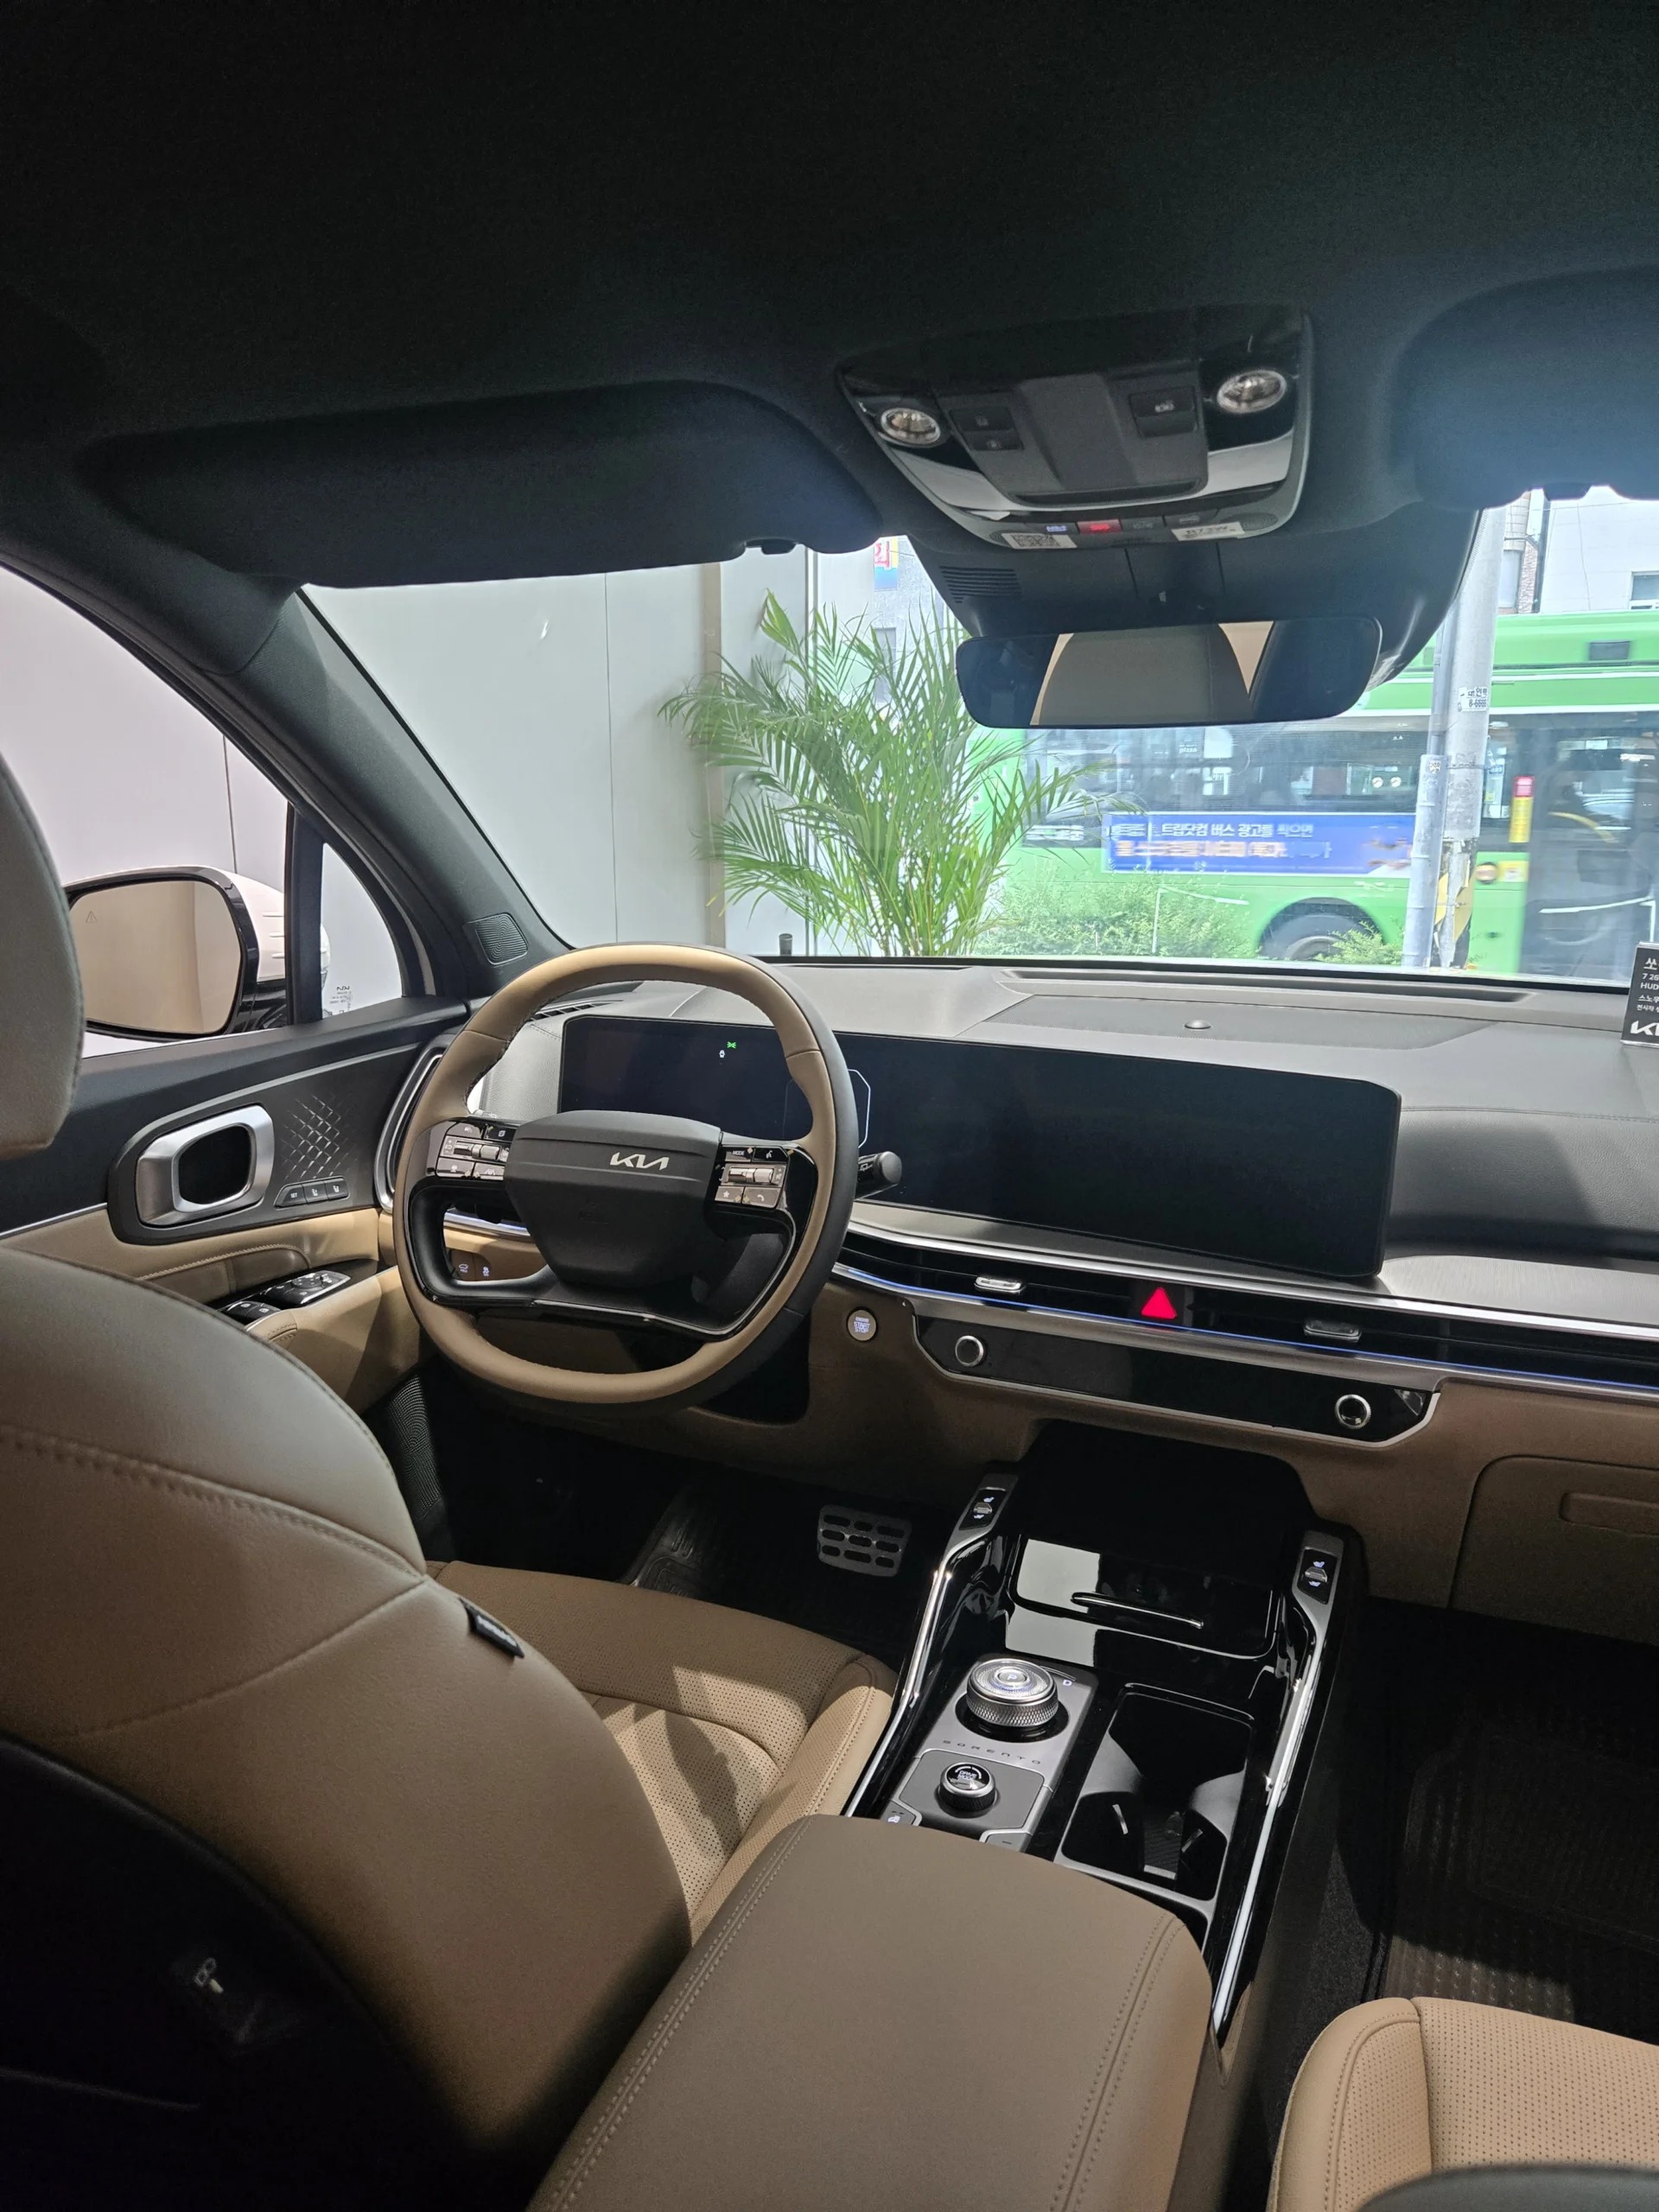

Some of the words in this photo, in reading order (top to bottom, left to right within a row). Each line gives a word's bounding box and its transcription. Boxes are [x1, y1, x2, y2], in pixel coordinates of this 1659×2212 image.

[1161, 823, 1208, 836] 트립닷컴
[1211, 823, 1234, 836] 버스
[1237, 823, 1274, 838] 광고를
[1643, 957, 1659, 970] 쏘
[610, 1153, 669, 1170] KIA
[943, 1740, 1040, 1764] SORENTO
